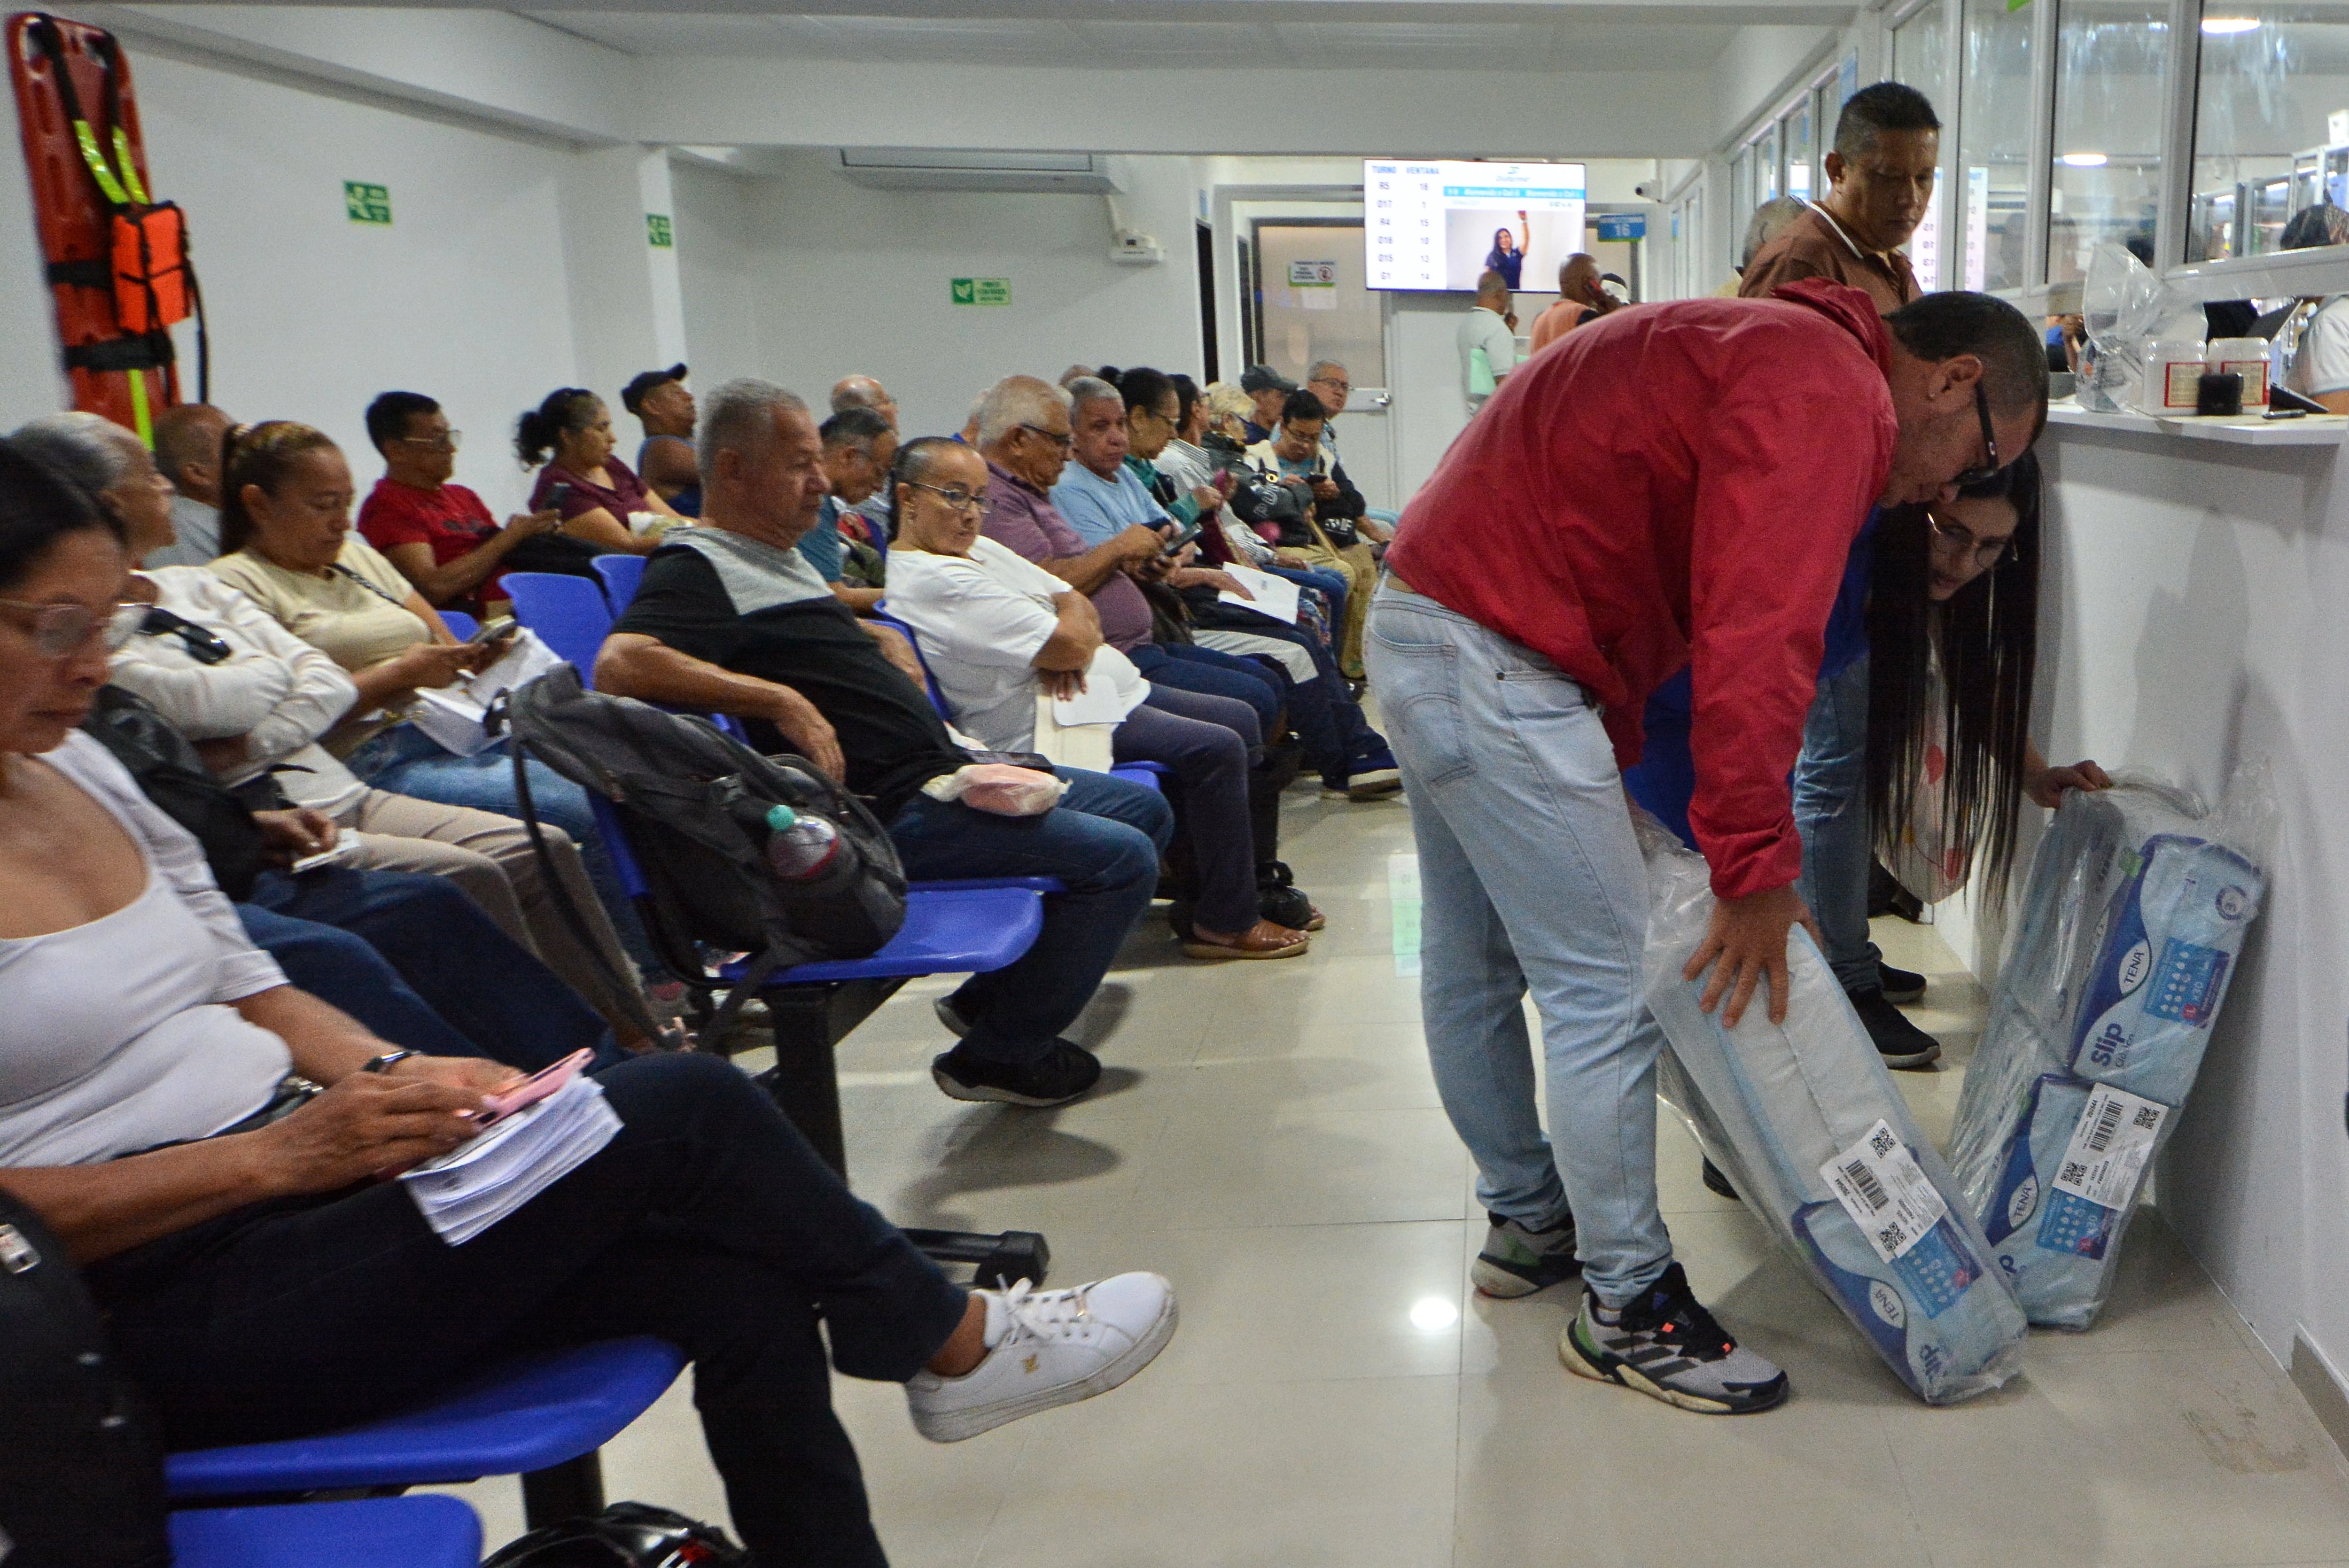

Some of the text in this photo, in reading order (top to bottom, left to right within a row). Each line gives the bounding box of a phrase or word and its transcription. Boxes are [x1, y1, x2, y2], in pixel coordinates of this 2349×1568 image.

[2123, 952, 2145, 983] TENA
[2091, 1023, 2126, 1067] Slip
[2014, 1186, 2032, 1217] TENA
[1874, 1289, 1899, 1320] TENA
